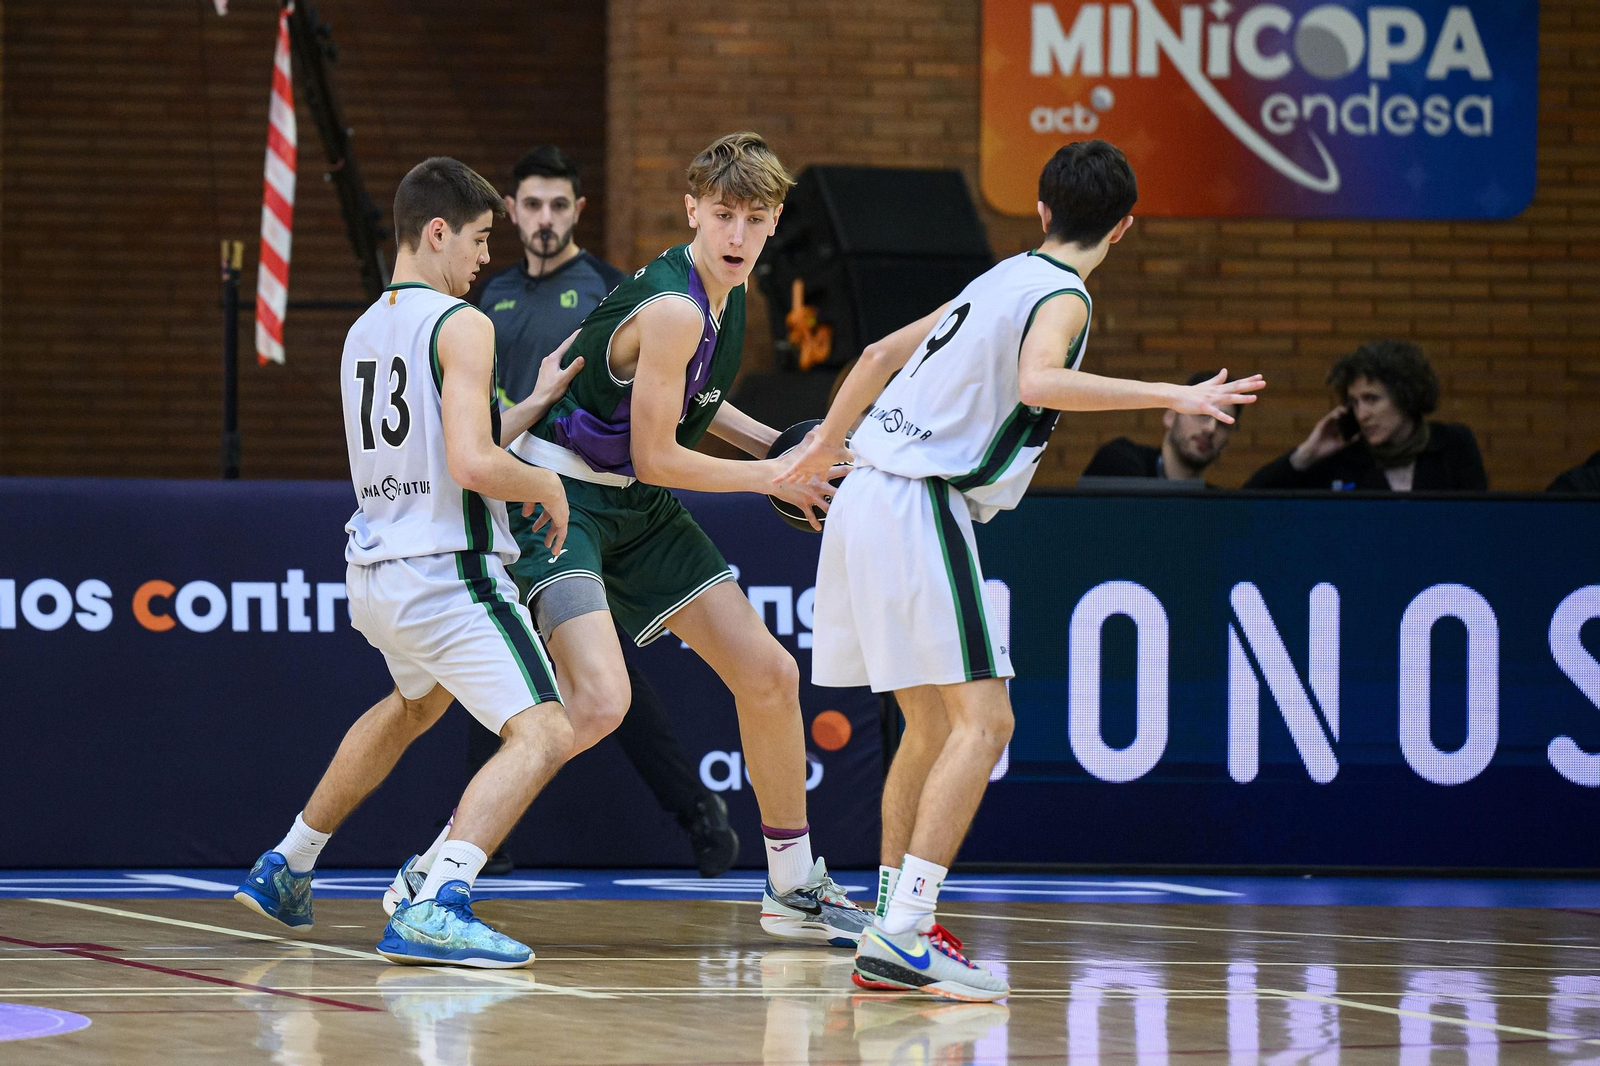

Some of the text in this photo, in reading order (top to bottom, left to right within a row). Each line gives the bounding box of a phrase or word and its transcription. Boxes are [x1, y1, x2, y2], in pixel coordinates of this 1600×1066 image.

[1030, 98, 1102, 134] acb
[1261, 84, 1493, 136] endesa
[909, 301, 971, 379] 9
[355, 355, 412, 453] 13
[132, 569, 354, 633] contr
